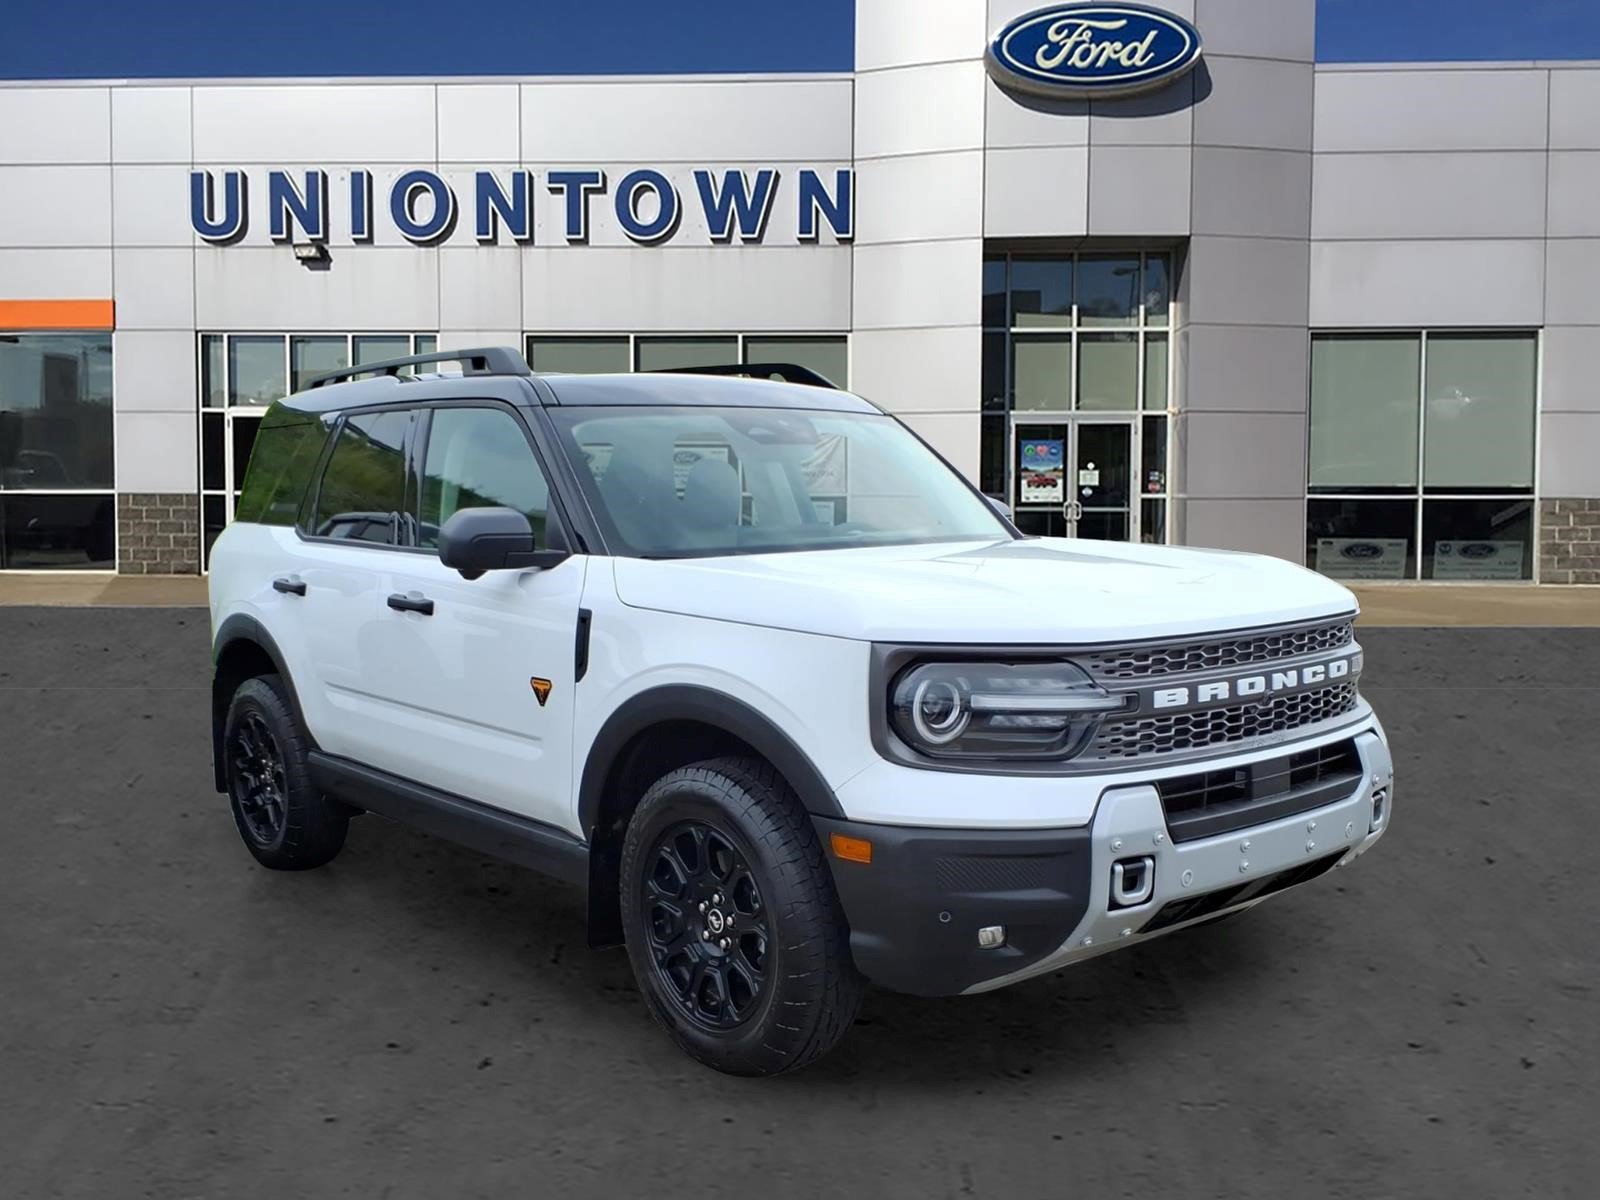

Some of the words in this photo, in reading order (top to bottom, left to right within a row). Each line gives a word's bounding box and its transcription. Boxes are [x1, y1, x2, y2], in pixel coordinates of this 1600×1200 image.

[1035, 18, 1159, 69] Ford
[190, 169, 855, 245] UNIONTOWN
[1153, 659, 1349, 709] BRONCO
